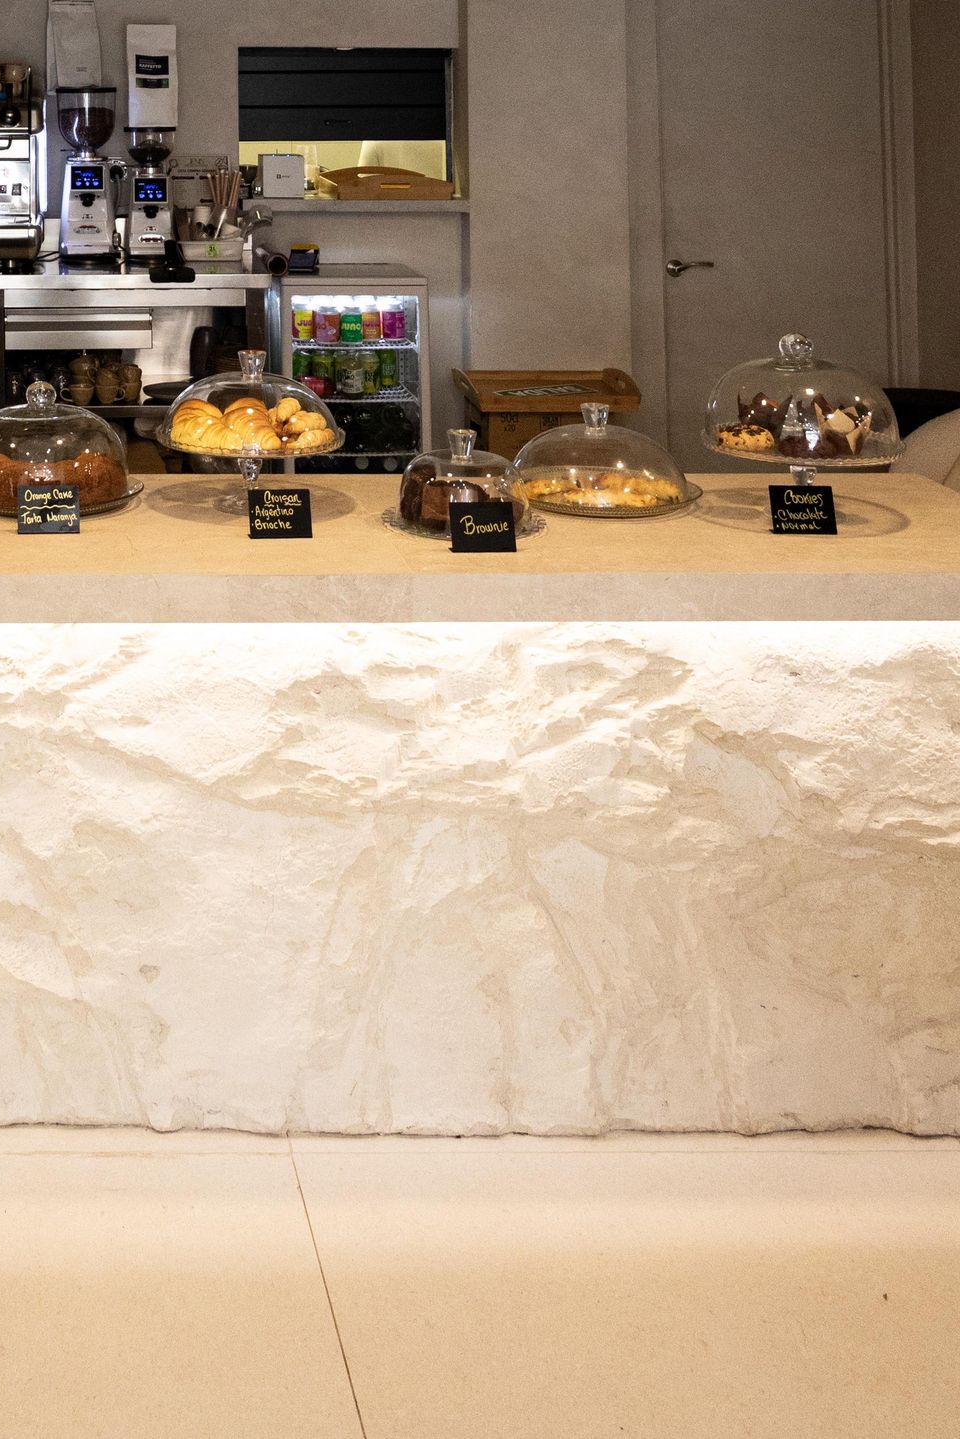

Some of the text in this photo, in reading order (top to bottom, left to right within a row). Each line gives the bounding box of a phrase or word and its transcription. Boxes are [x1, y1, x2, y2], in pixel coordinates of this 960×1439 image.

[24, 489, 52, 505] Orange
[783, 489, 824, 507] Cookies
[20, 511, 78, 527] Tarta Naranja
[255, 505, 294, 521] Argentino
[777, 506, 829, 521] Chocolate
[254, 518, 293, 530] Brioche
[459, 514, 510, 535] Brownie
